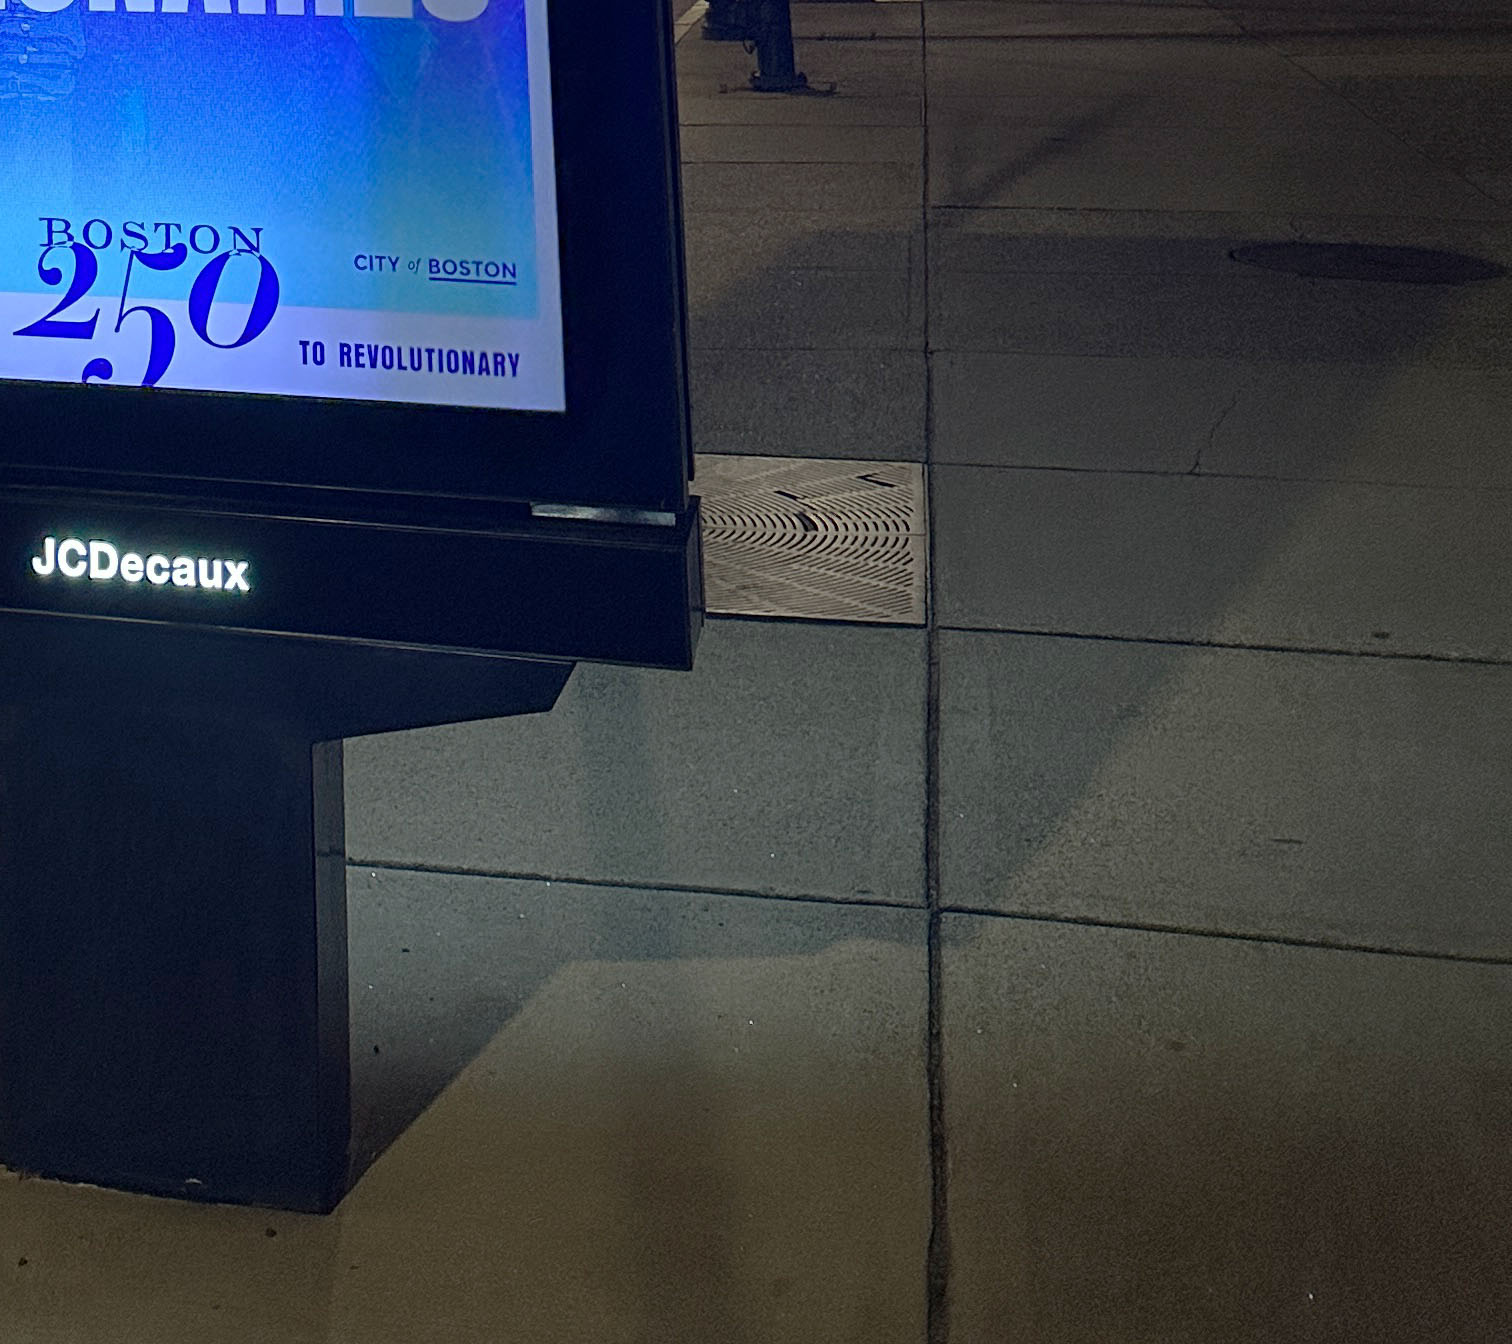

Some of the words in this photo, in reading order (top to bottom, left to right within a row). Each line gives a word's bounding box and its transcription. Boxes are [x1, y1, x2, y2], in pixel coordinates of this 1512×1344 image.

[38, 217, 264, 259] BOSTON
[354, 254, 400, 273] CITY
[407, 257, 422, 276] of
[428, 258, 518, 279] BOSTON
[12, 241, 281, 389] 250
[299, 340, 326, 367] TO
[339, 342, 520, 378] REVOLUTIONARY
[31, 535, 252, 593] JCDecaux
